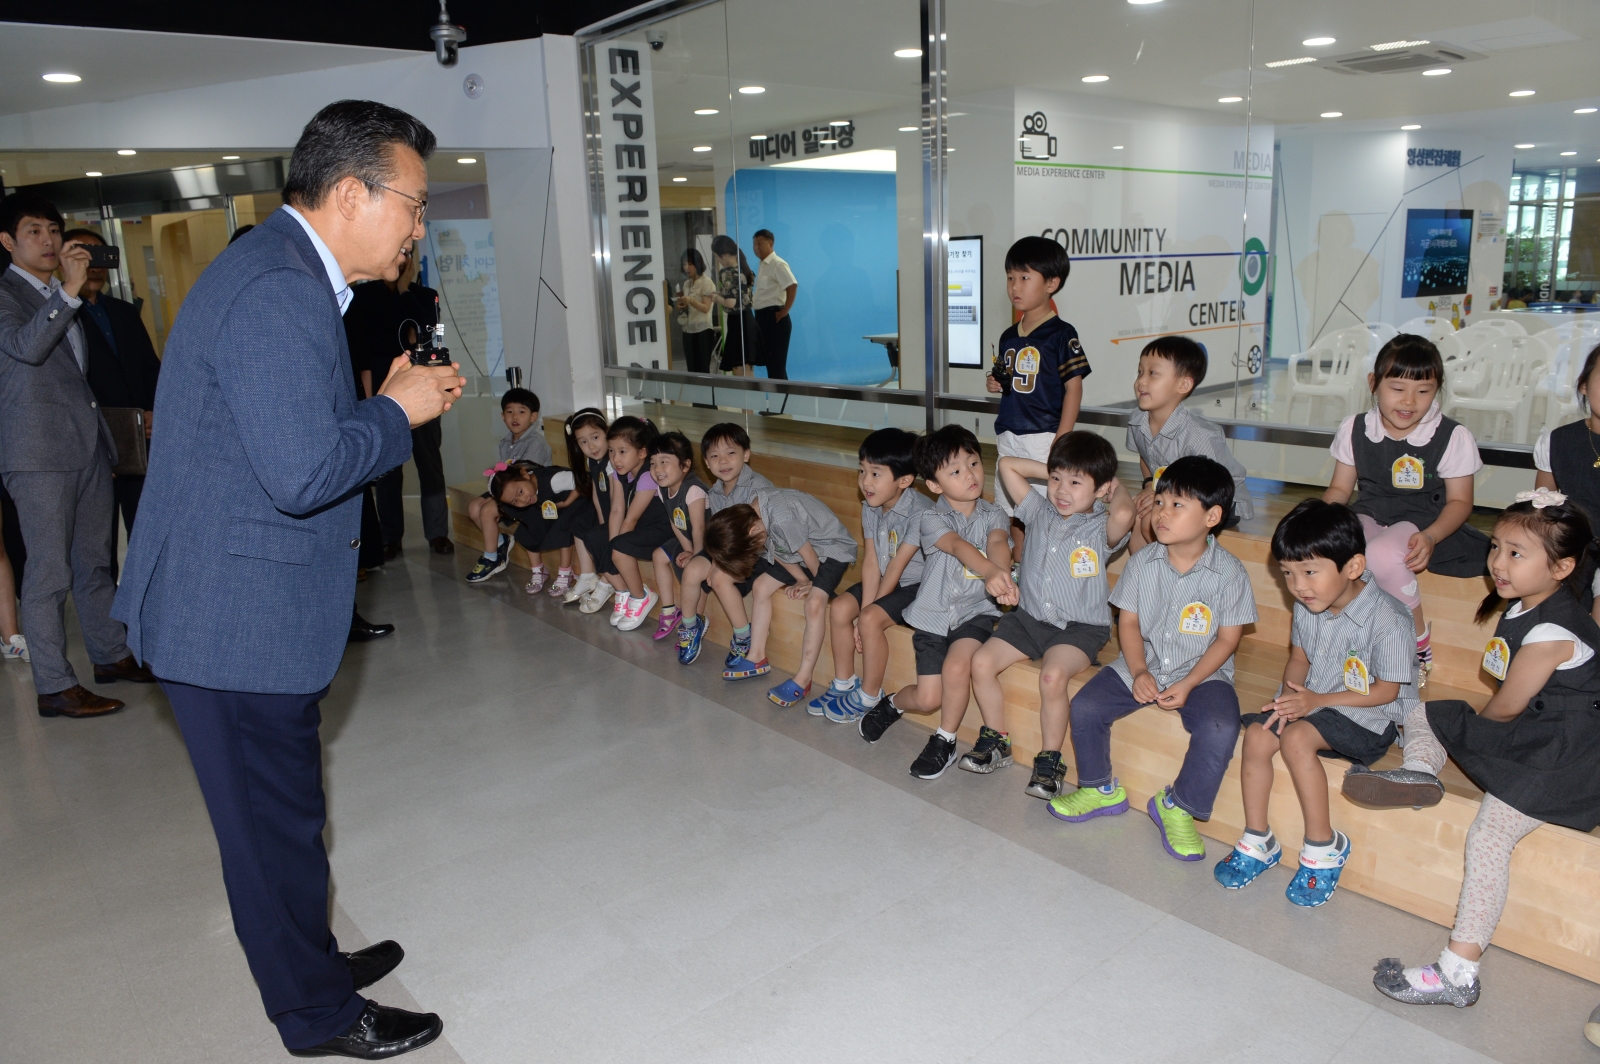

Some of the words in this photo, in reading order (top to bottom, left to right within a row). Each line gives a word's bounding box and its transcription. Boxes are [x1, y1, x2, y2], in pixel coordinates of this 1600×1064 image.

[749, 130, 796, 162] 미디어
[802, 120, 856, 154] 일기장
[1016, 166, 1040, 176] MEDIA
[1042, 167, 1080, 178] EXPERIENCE
[1082, 169, 1105, 179] CENTER
[1233, 150, 1272, 171] MEDIA
[608, 48, 658, 345] EXPERIENCE
[1208, 180, 1225, 188] MEDIA
[1226, 180, 1253, 190] EXPERIECE
[1119, 260, 1196, 296] MEDIA
[1188, 300, 1246, 327] CENTER
